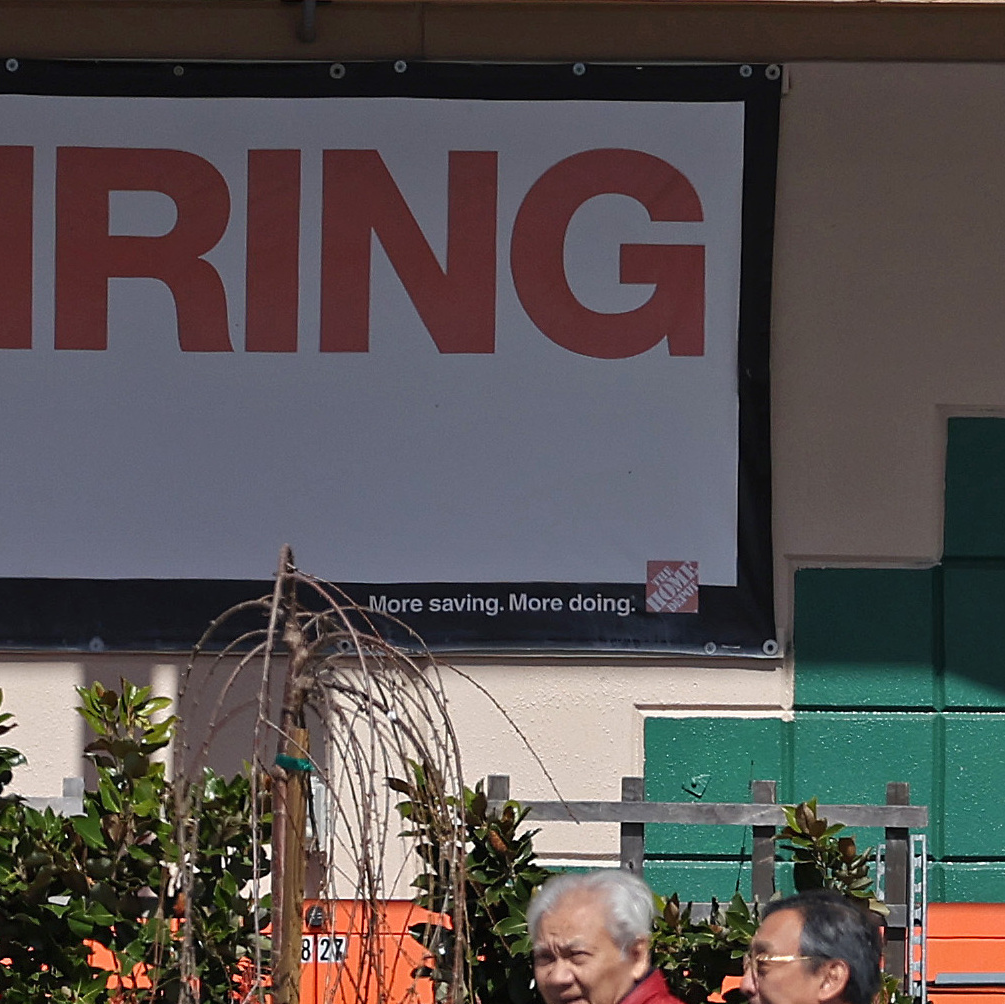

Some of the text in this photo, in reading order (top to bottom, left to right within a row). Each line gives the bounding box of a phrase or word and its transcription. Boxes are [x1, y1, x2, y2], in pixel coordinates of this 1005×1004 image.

[369, 593, 636, 616] More saving. More doing.
[646, 561, 699, 613] HOME
